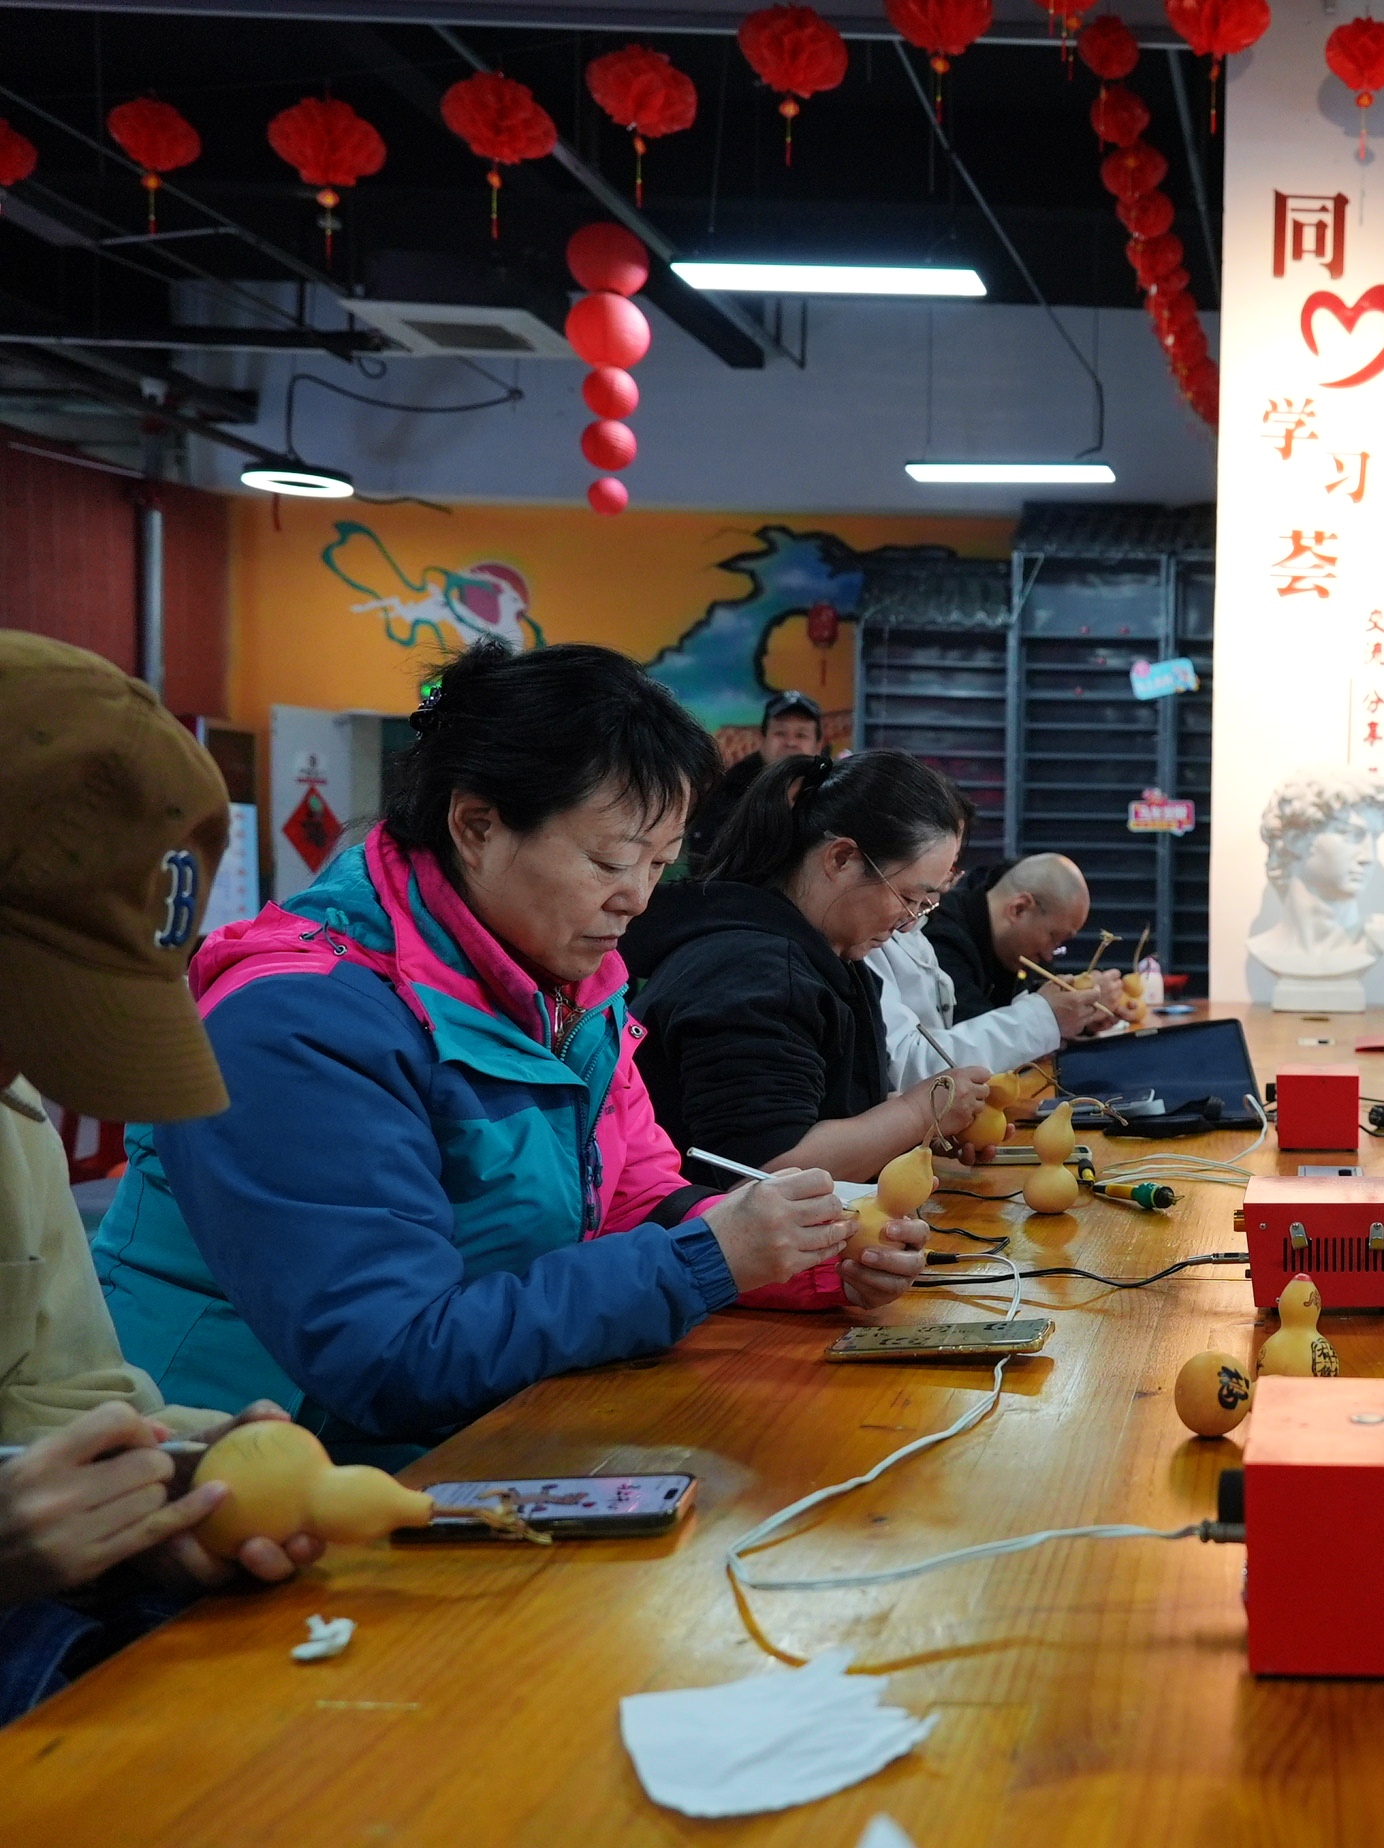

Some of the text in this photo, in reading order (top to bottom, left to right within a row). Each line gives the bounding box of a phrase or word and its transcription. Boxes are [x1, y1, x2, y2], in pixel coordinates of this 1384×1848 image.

[1260, 187, 1371, 600] 同 学习荟
[153, 849, 198, 949] B
